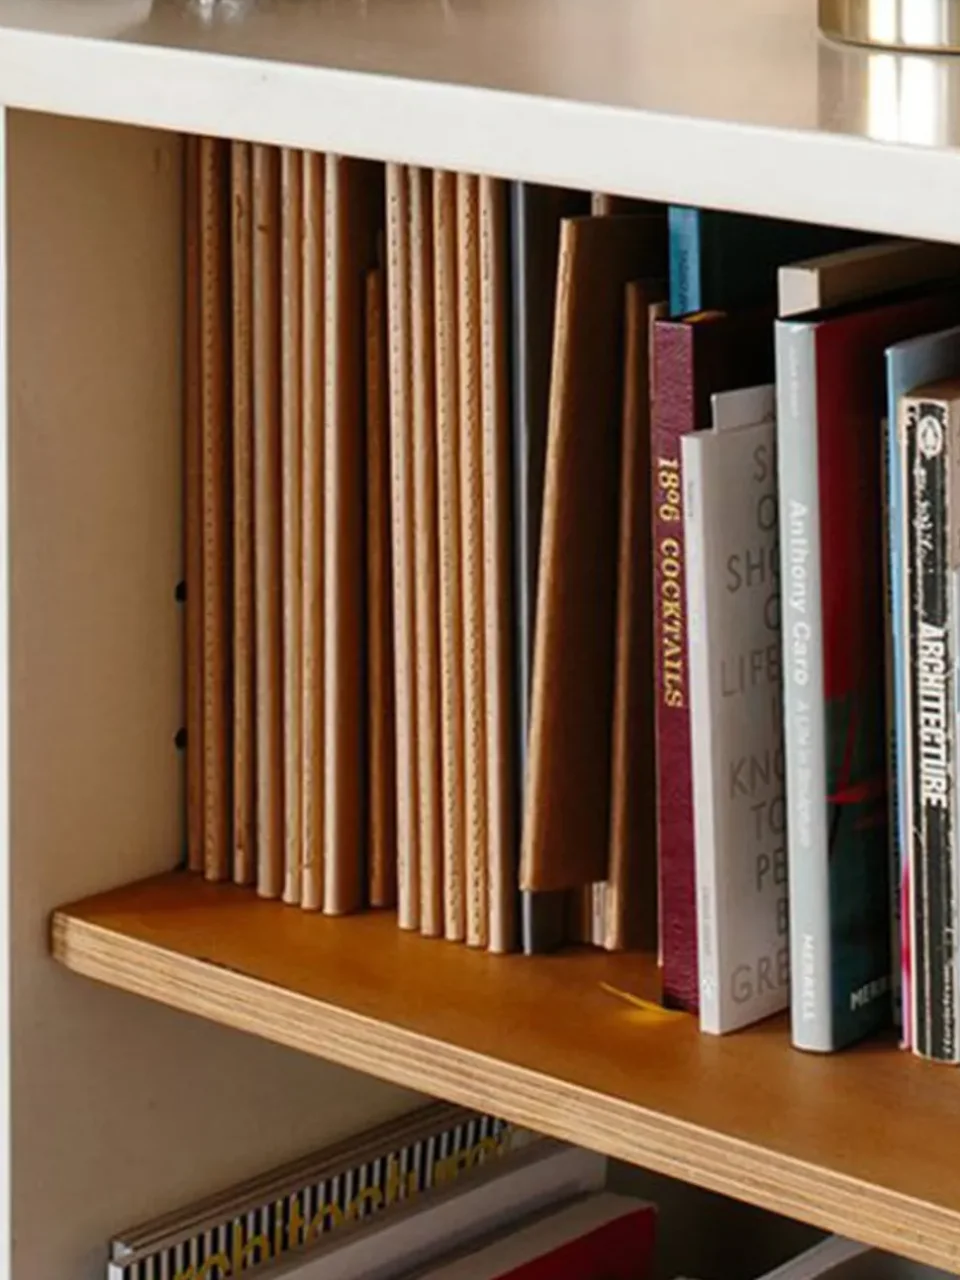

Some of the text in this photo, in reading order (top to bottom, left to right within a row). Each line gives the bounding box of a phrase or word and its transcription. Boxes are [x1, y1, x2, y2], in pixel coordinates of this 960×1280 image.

[660, 537, 684, 709] COCKTAILS
[789, 499, 811, 686] Anthony Caro
[918, 620, 948, 809] ARCHITECTURE
